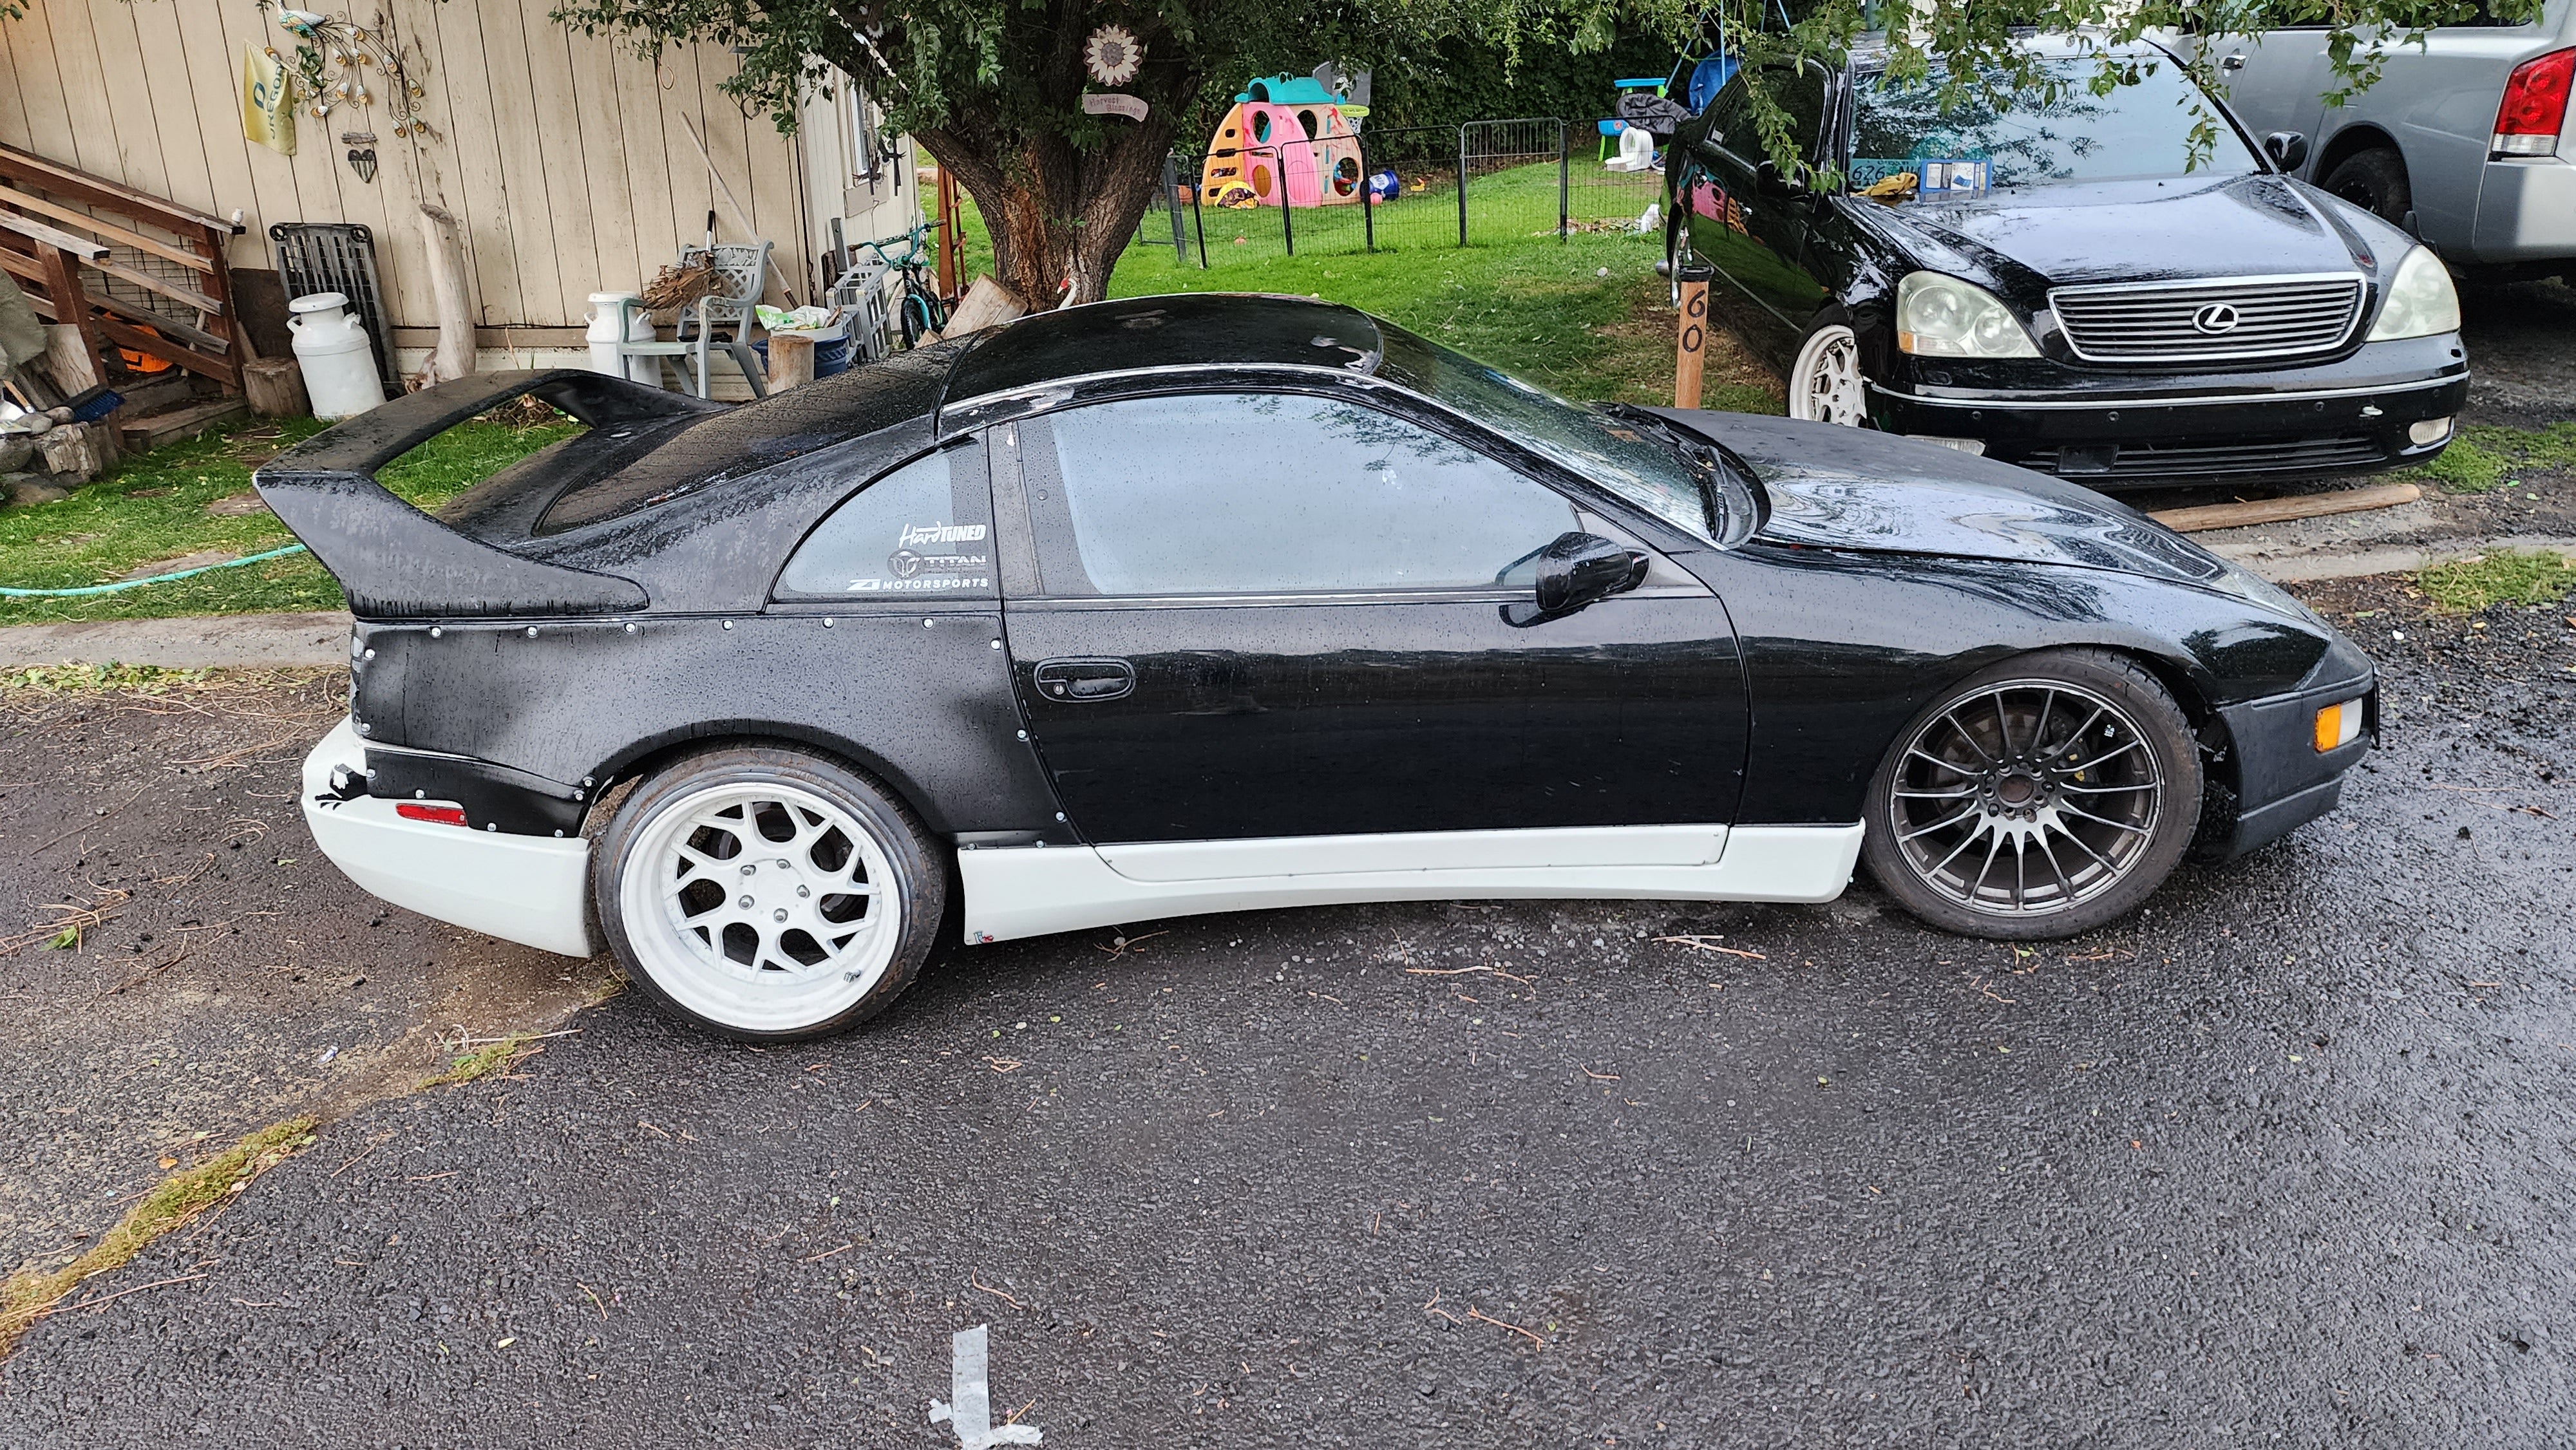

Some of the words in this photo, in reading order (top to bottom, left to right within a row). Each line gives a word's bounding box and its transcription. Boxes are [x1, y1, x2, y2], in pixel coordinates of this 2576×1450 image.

[1852, 165, 1886, 180] 626
[1683, 290, 1705, 352] 60
[923, 555, 987, 567] TITAN
[883, 578, 989, 590] MOTORSPORTS
